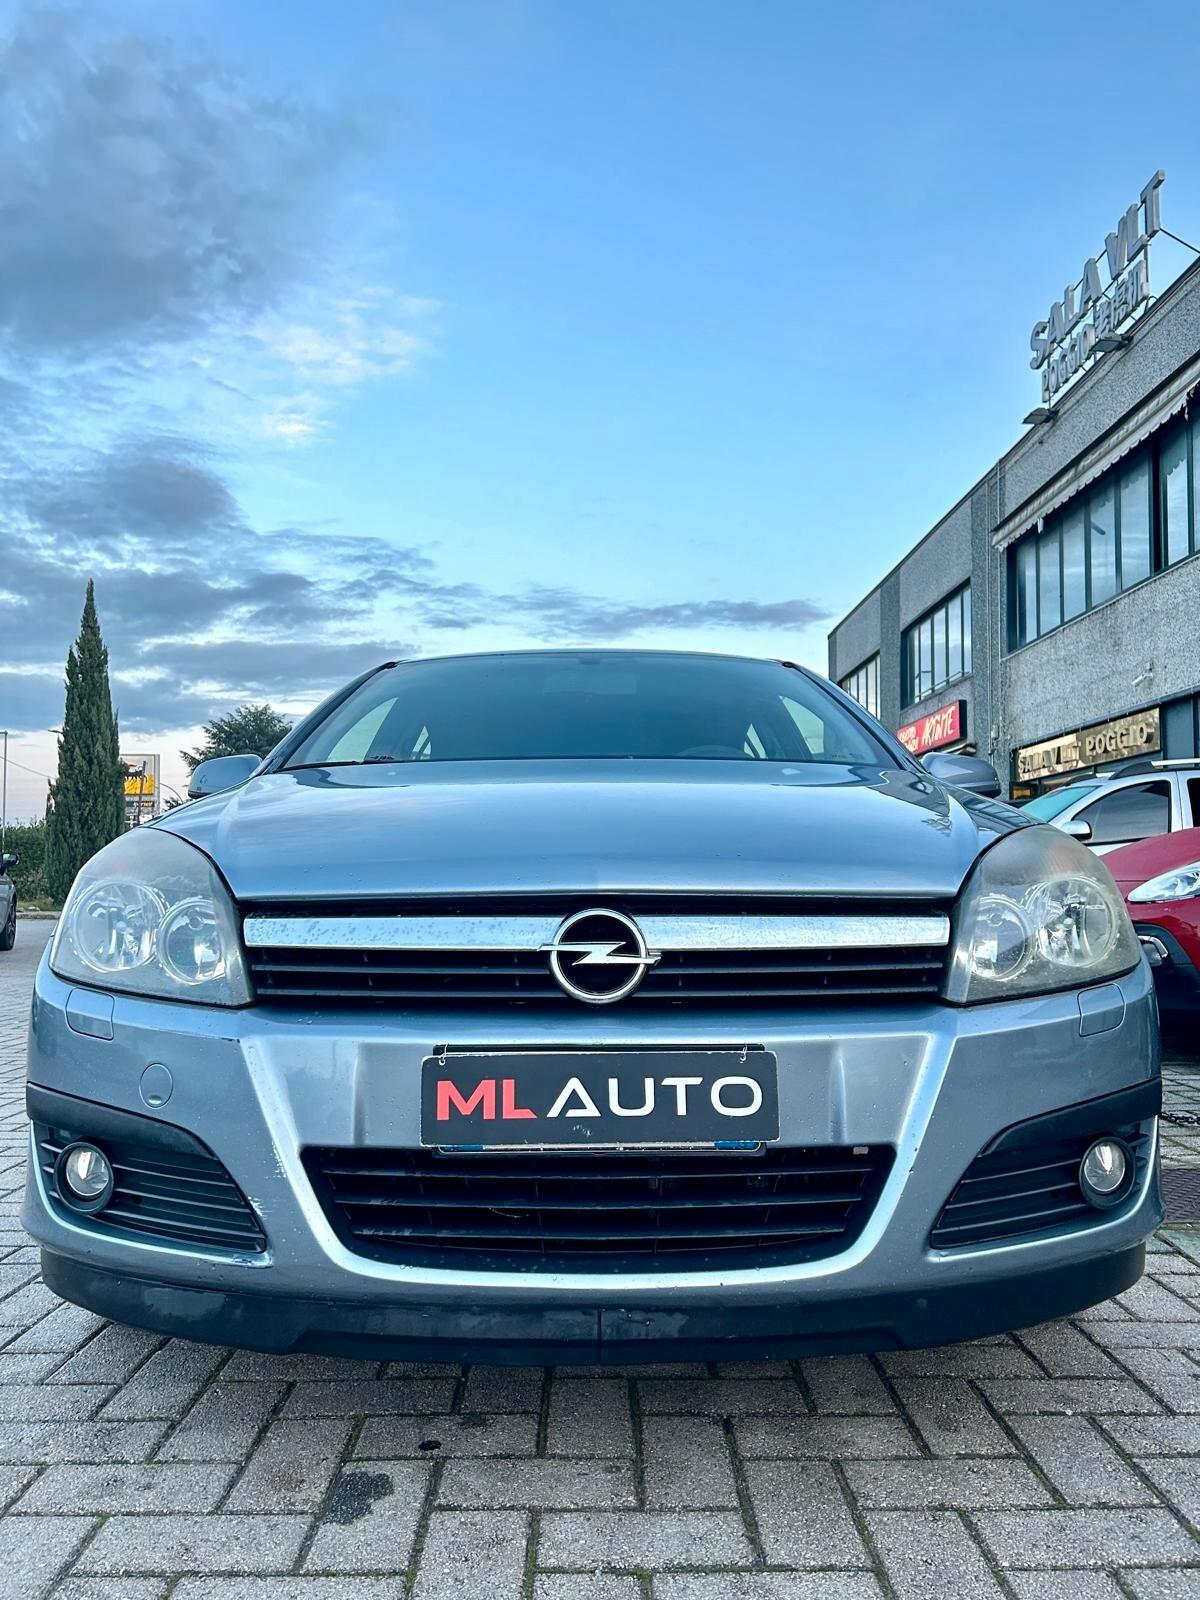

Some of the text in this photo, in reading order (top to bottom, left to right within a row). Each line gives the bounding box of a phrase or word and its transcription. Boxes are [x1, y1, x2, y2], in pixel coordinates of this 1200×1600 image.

[1030, 169, 1165, 370] SALA VLT
[1042, 323, 1096, 403] POGGIO
[1085, 721, 1150, 757] POGGIO
[436, 1076, 763, 1121] ML AUTO
